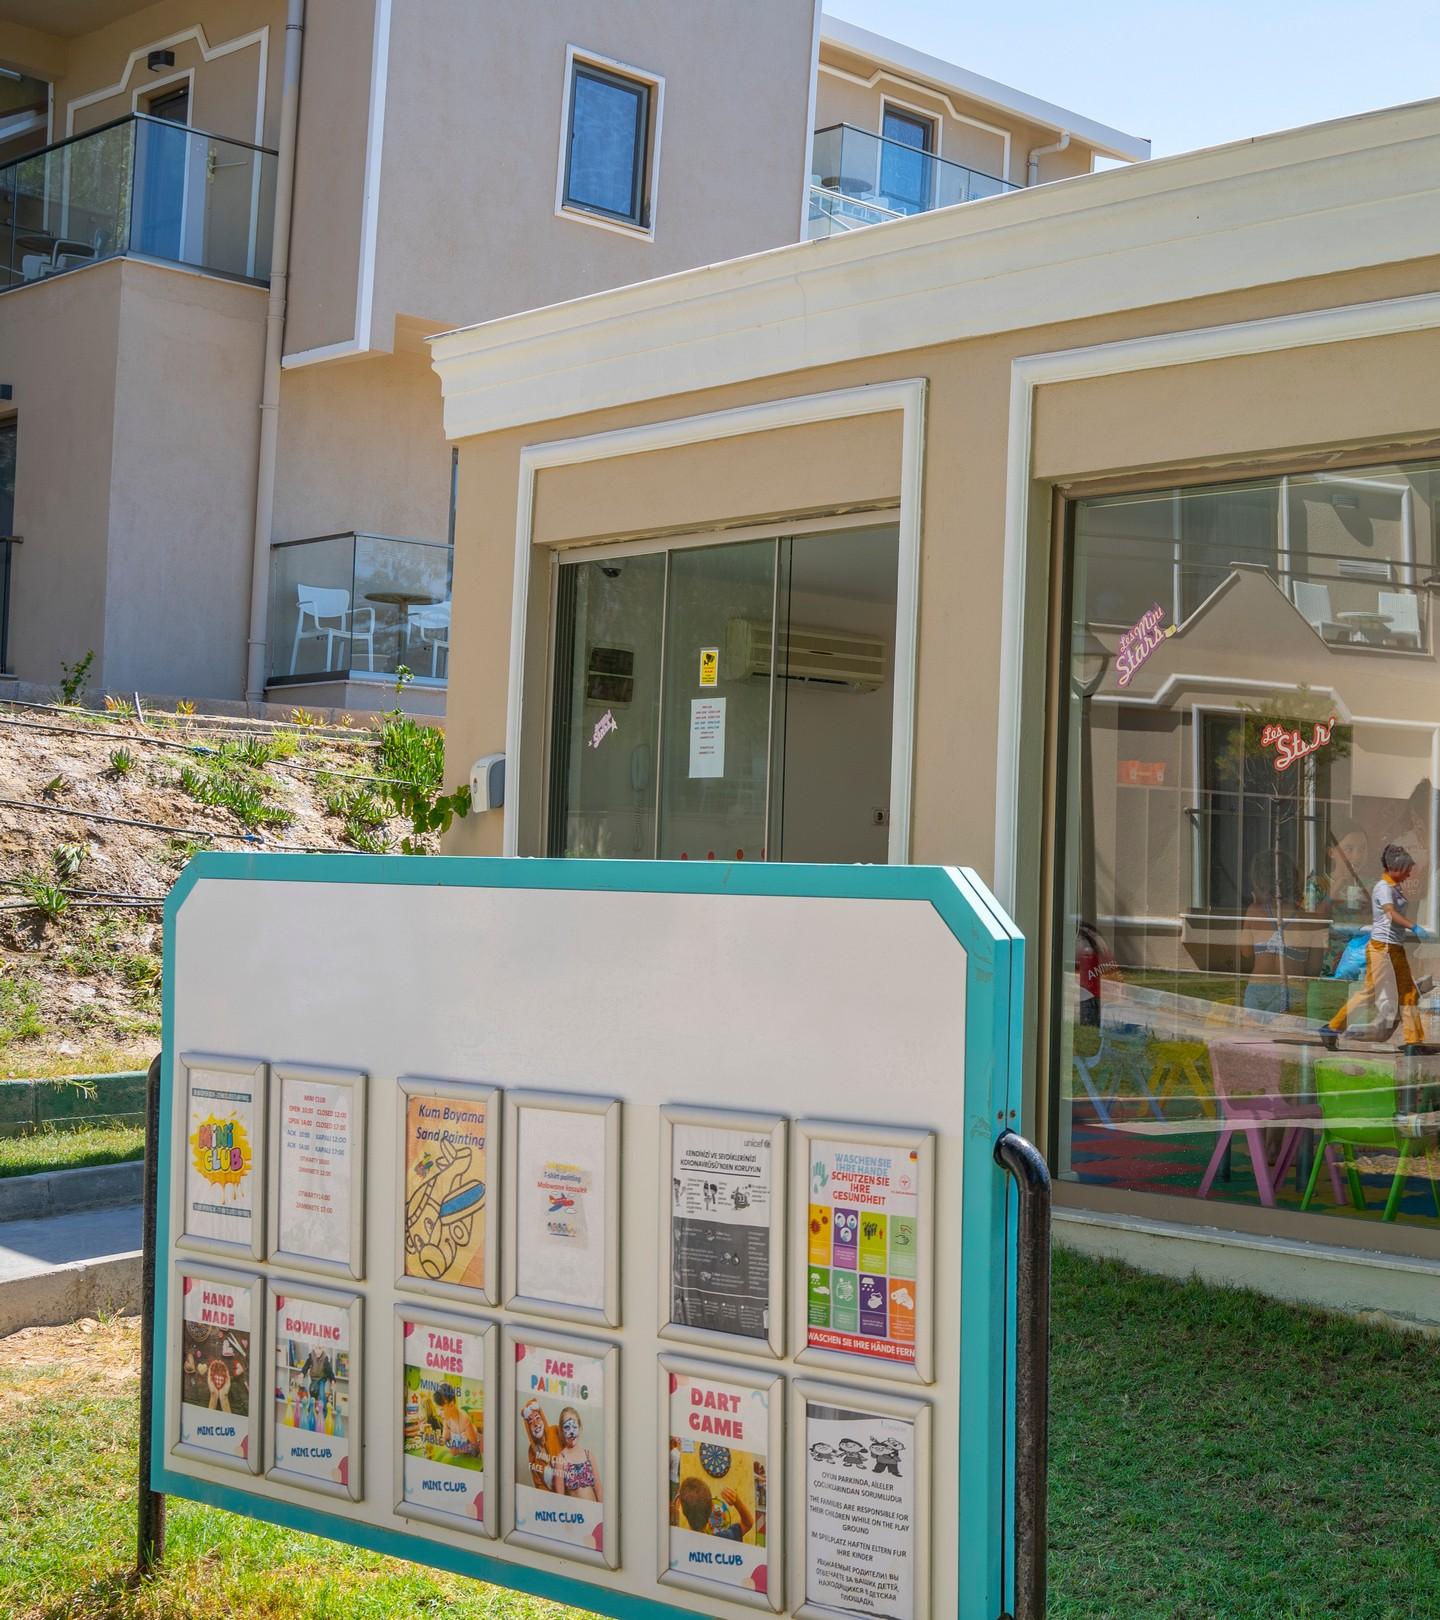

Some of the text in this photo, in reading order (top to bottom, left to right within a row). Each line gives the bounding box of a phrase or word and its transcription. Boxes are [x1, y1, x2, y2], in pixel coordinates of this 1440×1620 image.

[1115, 624, 1165, 687] Stars
[1261, 725, 1284, 745] Les
[419, 1104, 485, 1125] Kum Boyama
[416, 1126, 486, 1150] Sand Painting
[743, 1138, 764, 1149] unicef
[204, 1147, 243, 1172] CLUB
[834, 1153, 878, 1168] WASCHEN
[850, 1184, 871, 1194] IHRE
[875, 1176, 891, 1187] SIE
[832, 1190, 886, 1206] GESUNDHEIT
[203, 1291, 235, 1309] HAND
[201, 1308, 236, 1327] MADE
[285, 1317, 341, 1341] BOWLING
[427, 1333, 464, 1355] TABLE
[842, 1337, 853, 1347] SIE
[853, 1339, 870, 1350] IHRE
[870, 1340, 896, 1354] HÄNDE
[896, 1346, 915, 1357] FERN
[425, 1351, 464, 1374] GAMES
[545, 1358, 574, 1379] FACE
[530, 1374, 588, 1401] PAINTING
[690, 1387, 741, 1414] DART
[196, 1426, 236, 1437] MINI CLUB
[688, 1412, 743, 1440] GAME
[290, 1447, 333, 1459] MINI CLUB
[422, 1479, 467, 1493] MINI CLUB
[535, 1511, 585, 1525] MINI CLUB
[810, 1495, 820, 1503] THE
[843, 1503, 855, 1512] ARE
[856, 1506, 895, 1519] RESPONSIBLE
[896, 1513, 909, 1522] FOR
[810, 1505, 910, 1532] THEIR CHILDREN WHILE ON THE PLAY
[842, 1524, 869, 1535] GROUND
[836, 1549, 874, 1562] IHRE KINDER
[847, 1540, 871, 1551] HAFTEN
[871, 1544, 892, 1556] ELTERN
[689, 1550, 743, 1567] MINI CLUB
[888, 1572, 899, 1581] ВЫ
